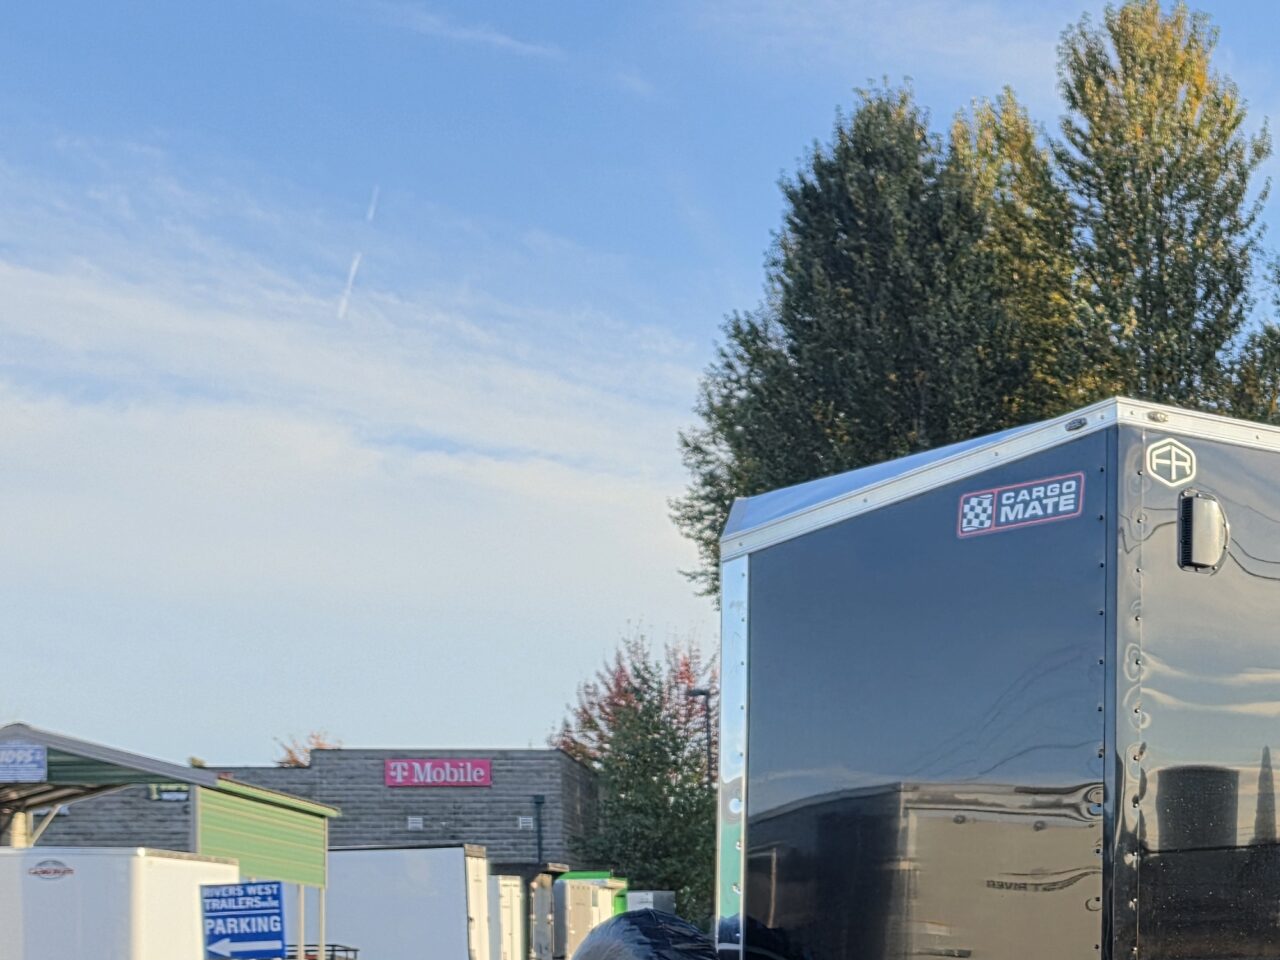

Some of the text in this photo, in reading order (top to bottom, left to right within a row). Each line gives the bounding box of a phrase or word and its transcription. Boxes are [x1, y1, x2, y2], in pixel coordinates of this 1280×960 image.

[1001, 480, 1077, 505] CARGO
[1000, 494, 1076, 523] MATE
[204, 883, 278, 898] RIVERS WEST
[204, 896, 261, 911] TRAILERS
[205, 915, 281, 935] PARKING
